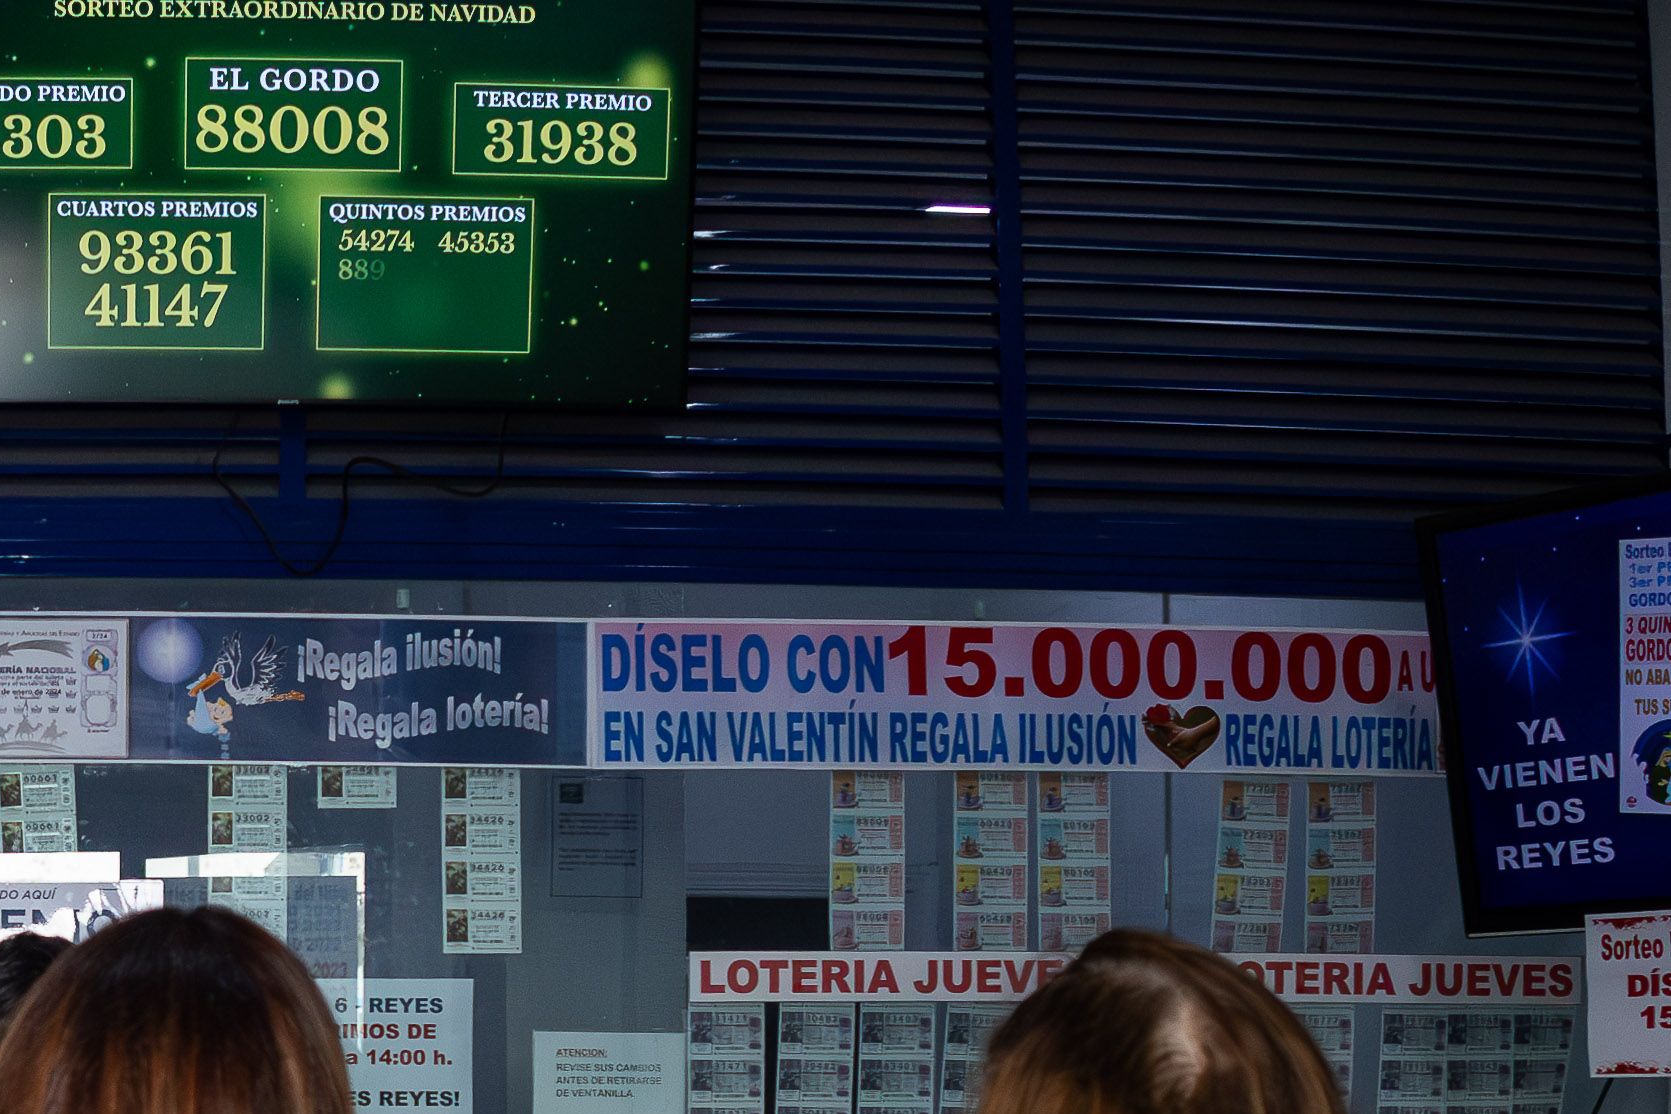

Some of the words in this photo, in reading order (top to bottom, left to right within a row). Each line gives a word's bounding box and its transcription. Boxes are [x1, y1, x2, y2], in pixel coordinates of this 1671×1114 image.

[54, 0, 153, 18] SORTEO
[159, 0, 384, 21] EXTRAORDINARIO
[391, 3, 424, 22] DE
[430, 4, 536, 24] NAVIDAD
[36, 84, 126, 104] PREMIO
[209, 67, 249, 92] EL
[259, 67, 380, 94] GORDO
[474, 90, 560, 109] TERCER
[565, 92, 653, 112] PREMIO
[195, 104, 390, 155] 88008
[483, 118, 638, 166] 31938
[56, 200, 156, 218] CUARTOS
[160, 200, 258, 219] PREMIOS
[329, 203, 426, 223] QUINTOS
[430, 204, 526, 224] PREMIOS
[78, 230, 238, 277] 93361
[338, 229, 415, 254] 54274
[438, 231, 515, 256] 45353
[84, 282, 229, 329] 41147
[1625, 544, 1664, 559] Sorteo
[297, 637, 396, 691] ¡Regala
[406, 627, 501, 675] ilusión!
[602, 622, 770, 693] DÍSELO
[787, 634, 885, 693] CON
[888, 624, 1392, 705] 15.000.000
[1397, 650, 1414, 692] A
[1625, 669, 1642, 685] NO
[327, 700, 437, 750] ¡Regala
[446, 691, 550, 735] lotería!
[1635, 699, 1659, 715] TUS
[604, 711, 644, 762] EN
[655, 710, 717, 763] SAN
[727, 698, 878, 764] VALENTÍN
[889, 711, 1009, 764] REGALA
[1019, 702, 1137, 766] ILUSIÓN
[1225, 713, 1324, 768] REGALA
[1331, 705, 1434, 771] LOTERÍA
[1517, 717, 1567, 746] YA
[1477, 752, 1616, 791] VIENEN
[1516, 797, 1585, 829] LOS
[1496, 836, 1616, 871] REYES
[22, 887, 58, 901] AQUÍ
[1601, 934, 1664, 961] Sorteo
[700, 959, 901, 994] LOTERIA
[1237, 960, 1397, 996] OTERIA
[1409, 962, 1574, 999] JUEVES
[335, 998, 347, 1013] 6
[368, 997, 444, 1014] REYES
[407, 1023, 438, 1039] DE
[366, 1049, 427, 1066] 14:00
[432, 1049, 453, 1065] h.
[556, 1063, 591, 1072] REVISE
[594, 1063, 614, 1072] SUS
[616, 1063, 662, 1072] CAMBIOS
[556, 1076, 589, 1085] ANTES
[591, 1076, 604, 1085] DE
[607, 1076, 662, 1085] RETIRARSE
[556, 1089, 569, 1097] DE
[379, 1090, 461, 1107] REYES!
